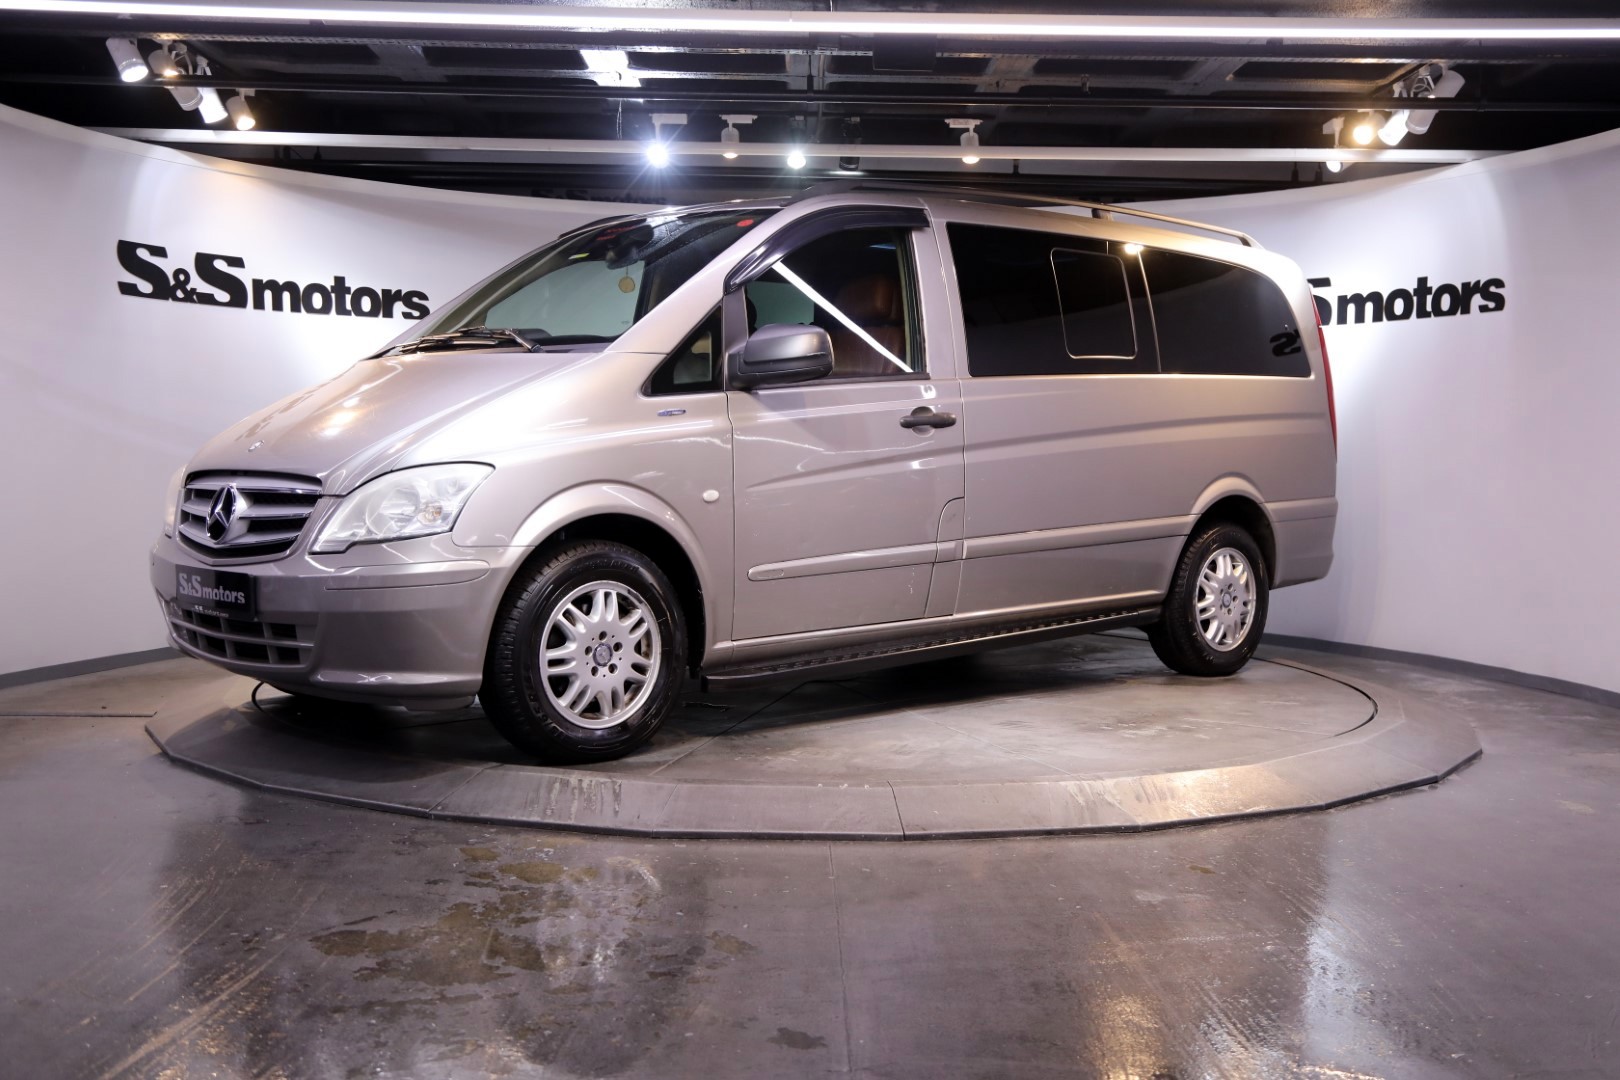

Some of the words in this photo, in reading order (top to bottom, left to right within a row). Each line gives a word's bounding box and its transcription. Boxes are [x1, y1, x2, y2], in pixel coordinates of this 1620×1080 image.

[117, 239, 248, 309] S&S
[252, 275, 430, 320] motors
[1337, 276, 1506, 325] motors
[202, 585, 246, 604] motors
